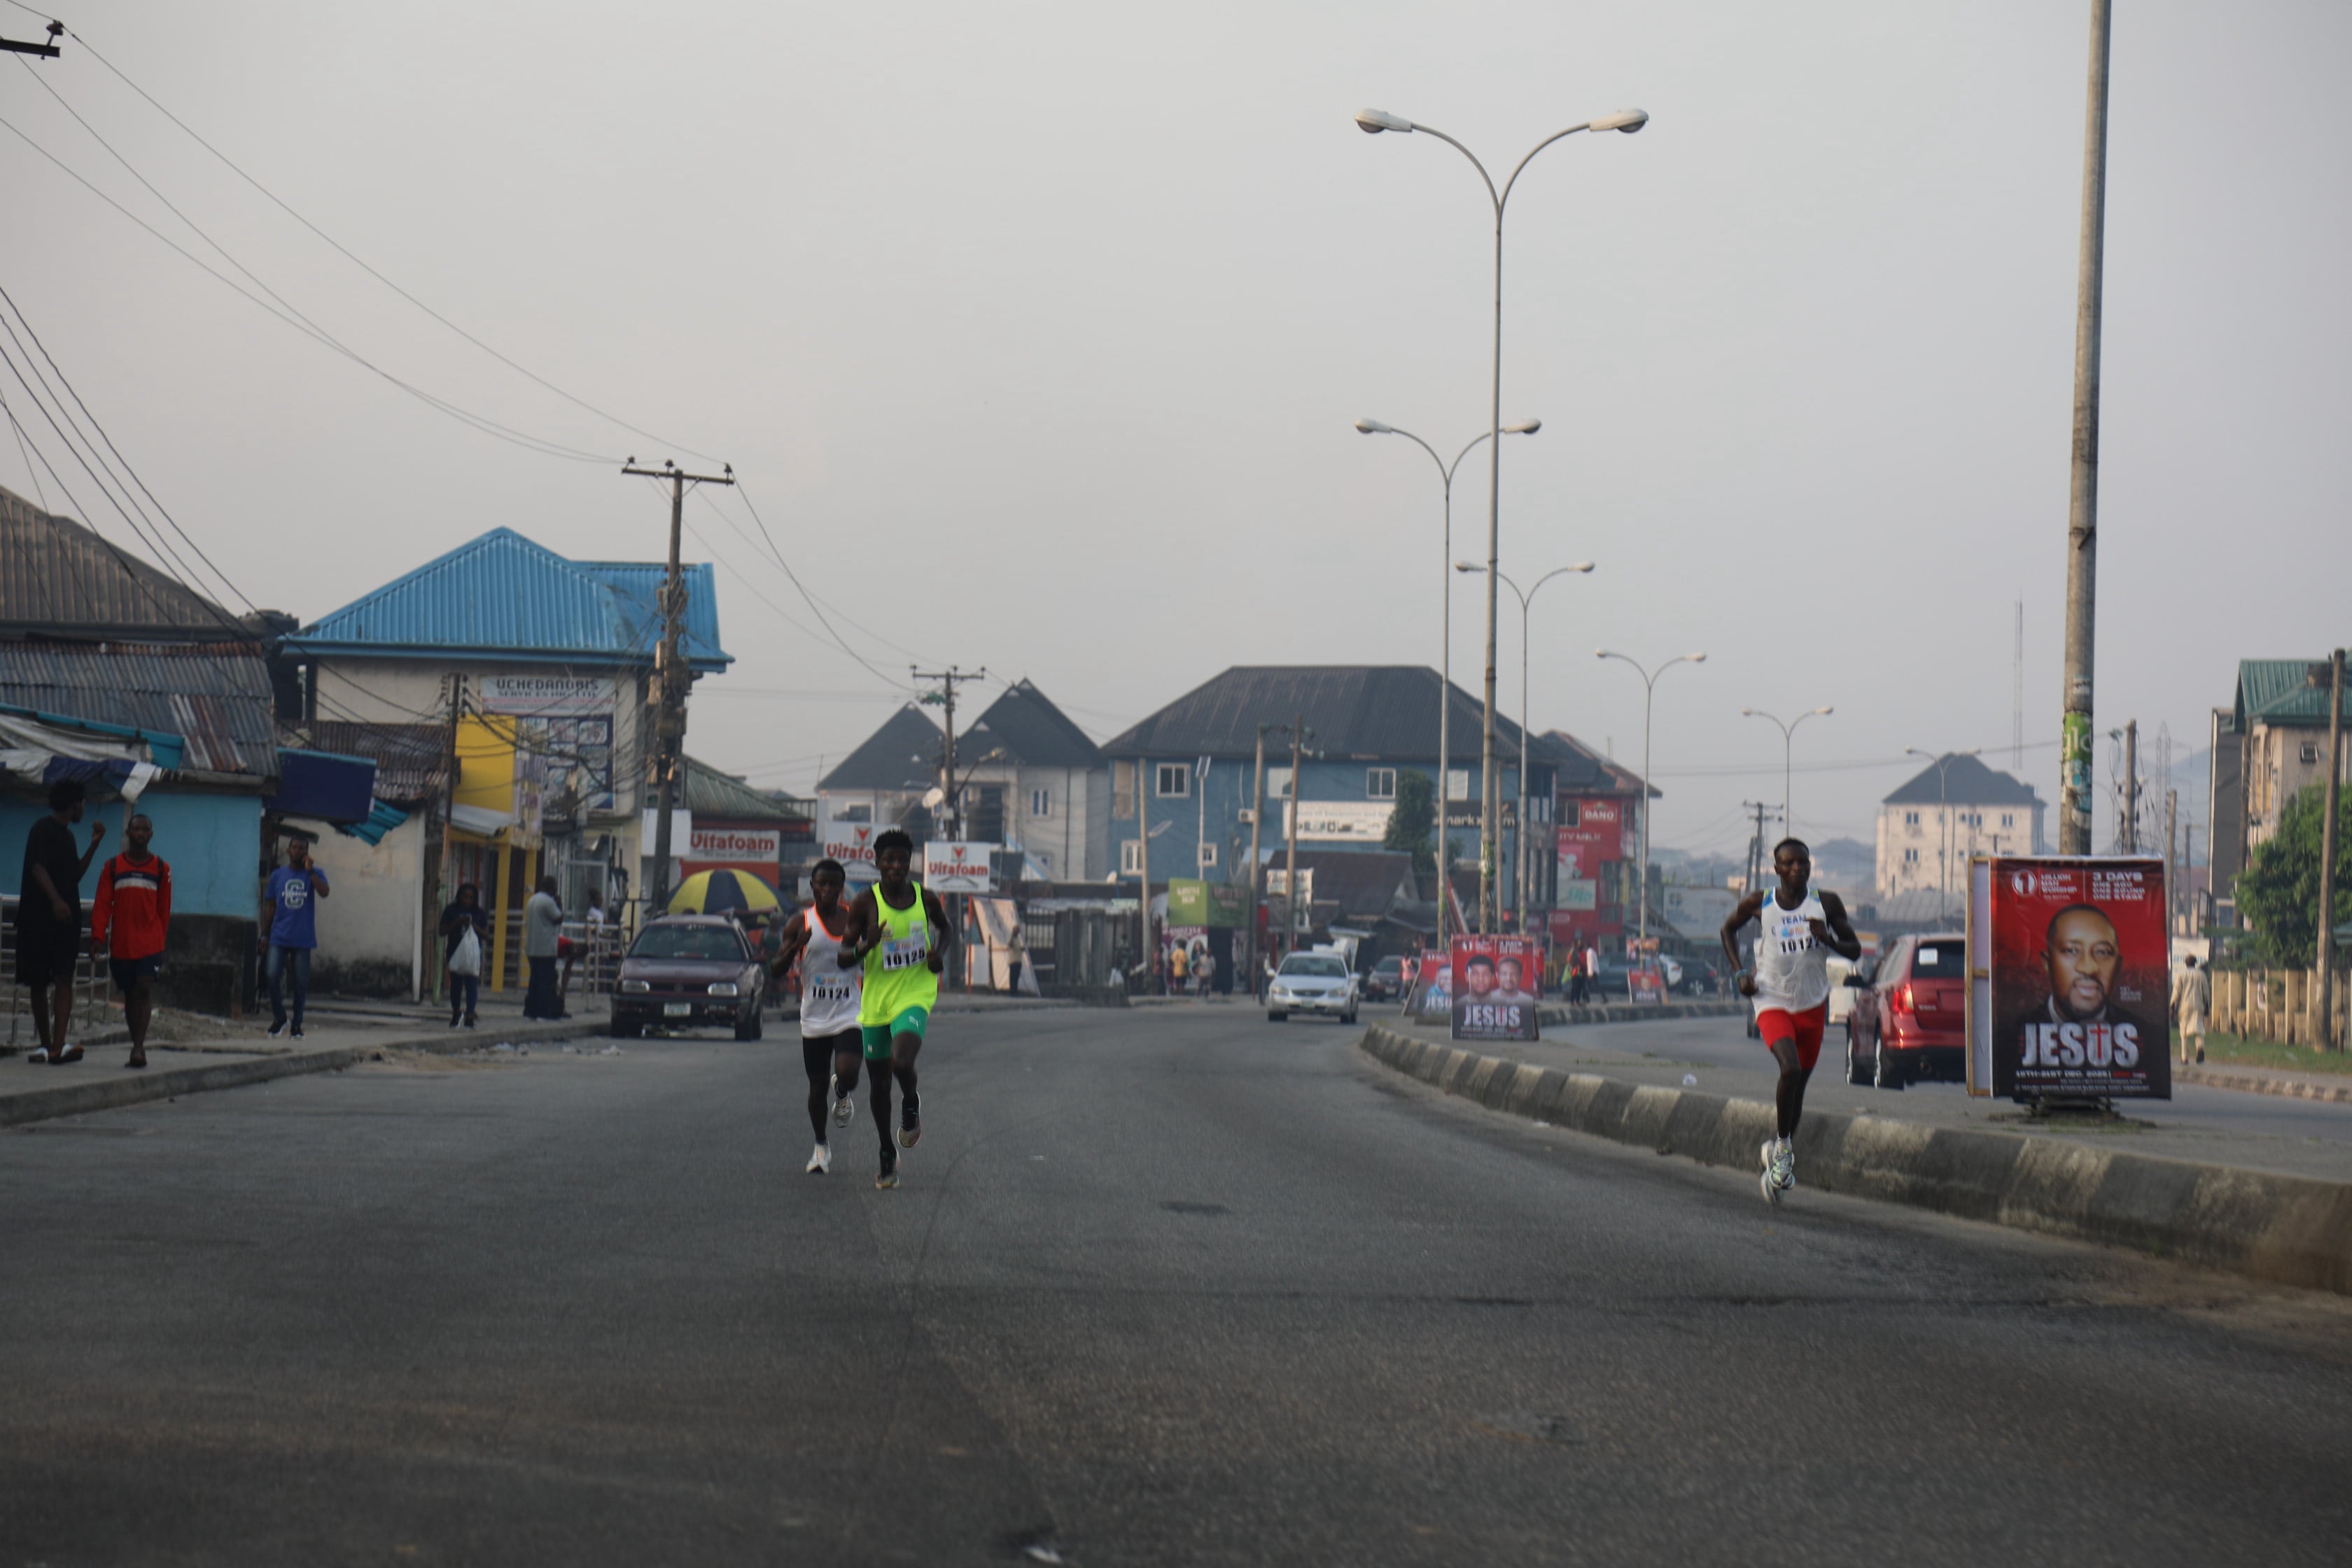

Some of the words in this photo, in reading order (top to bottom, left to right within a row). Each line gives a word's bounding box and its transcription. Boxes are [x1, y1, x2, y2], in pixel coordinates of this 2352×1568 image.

[1585, 810, 1614, 821] DANO
[690, 832, 775, 851] Vitafoam
[826, 842, 875, 860] Vitafo
[929, 862, 988, 876] Vitafoam
[2092, 872, 2101, 881] 3
[2106, 872, 2143, 881] DAYS
[1781, 913, 1806, 925] TEAM
[812, 986, 850, 1000] 10124
[1464, 1004, 1521, 1028] JESUS
[2022, 1023, 2140, 1068] JESUS
